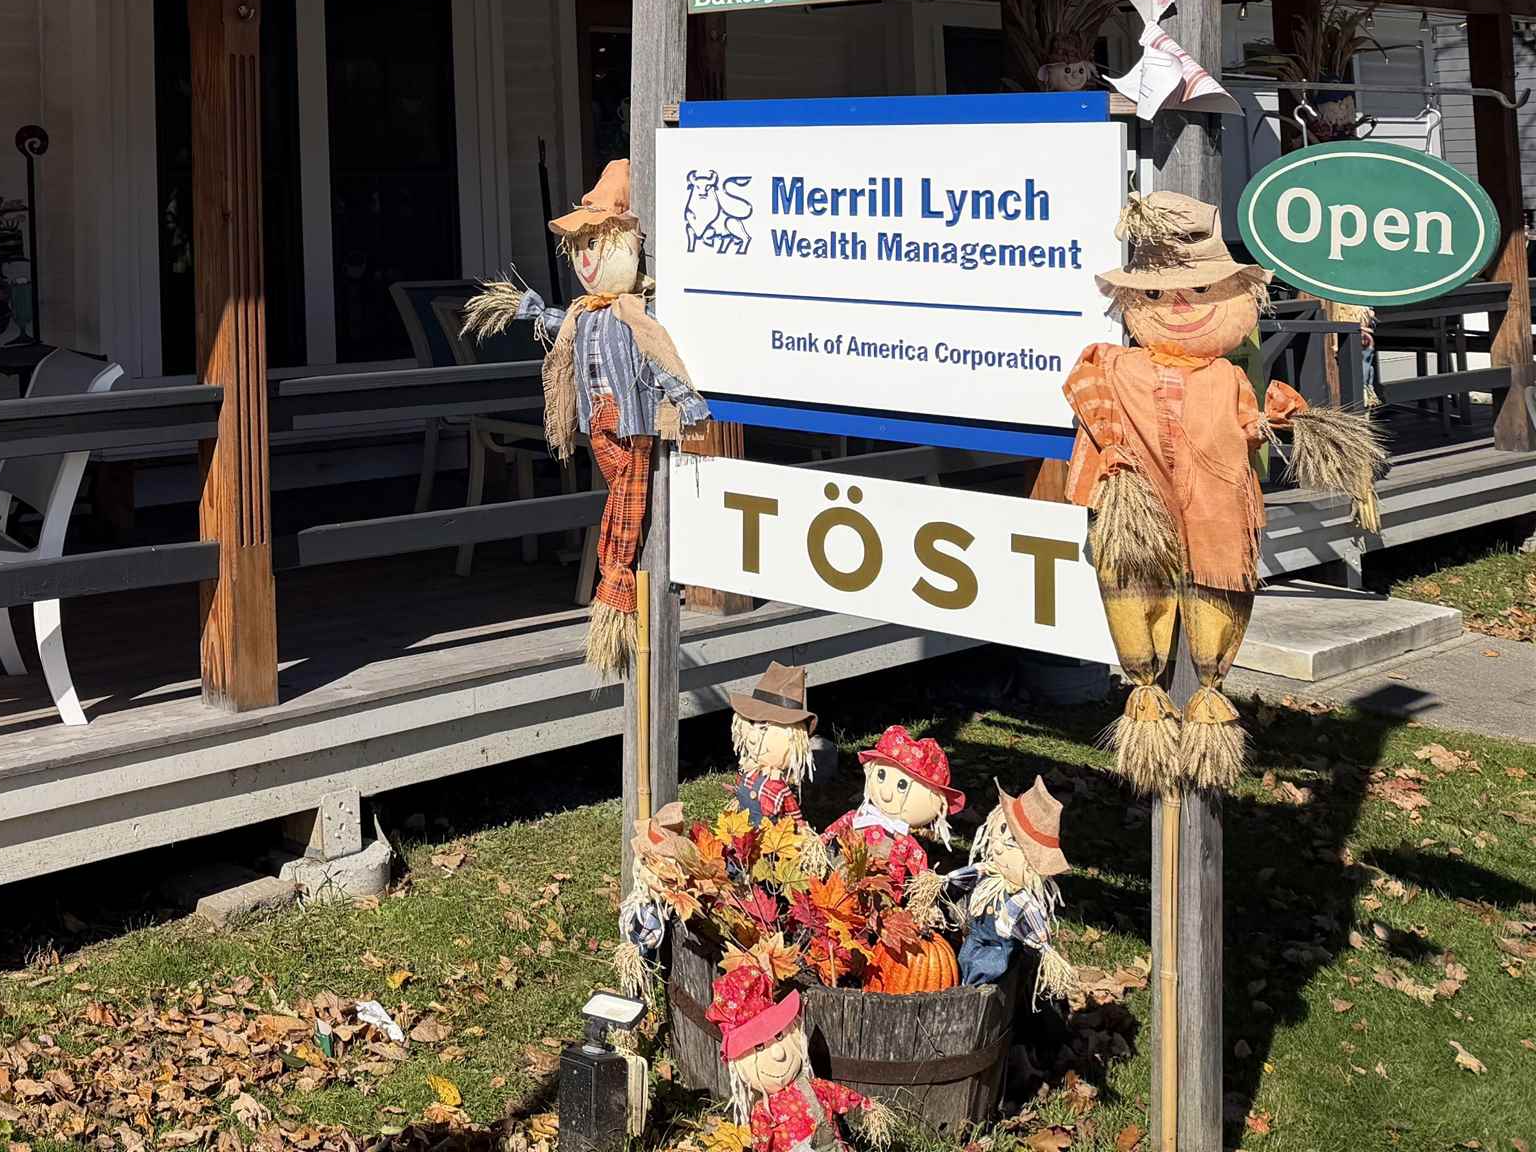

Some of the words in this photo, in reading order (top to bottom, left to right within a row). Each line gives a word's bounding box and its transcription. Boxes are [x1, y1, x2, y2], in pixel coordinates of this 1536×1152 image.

[771, 176, 903, 217] Merrill
[920, 177, 1050, 227] Lynch
[1276, 187, 1455, 261] Open
[770, 229, 867, 261] Wealth
[877, 232, 1082, 270] Management
[770, 329, 820, 354] Bank
[824, 333, 843, 356] of
[846, 334, 930, 363] America
[934, 341, 1062, 374] Corporation
[723, 481, 1080, 627] TÖST
